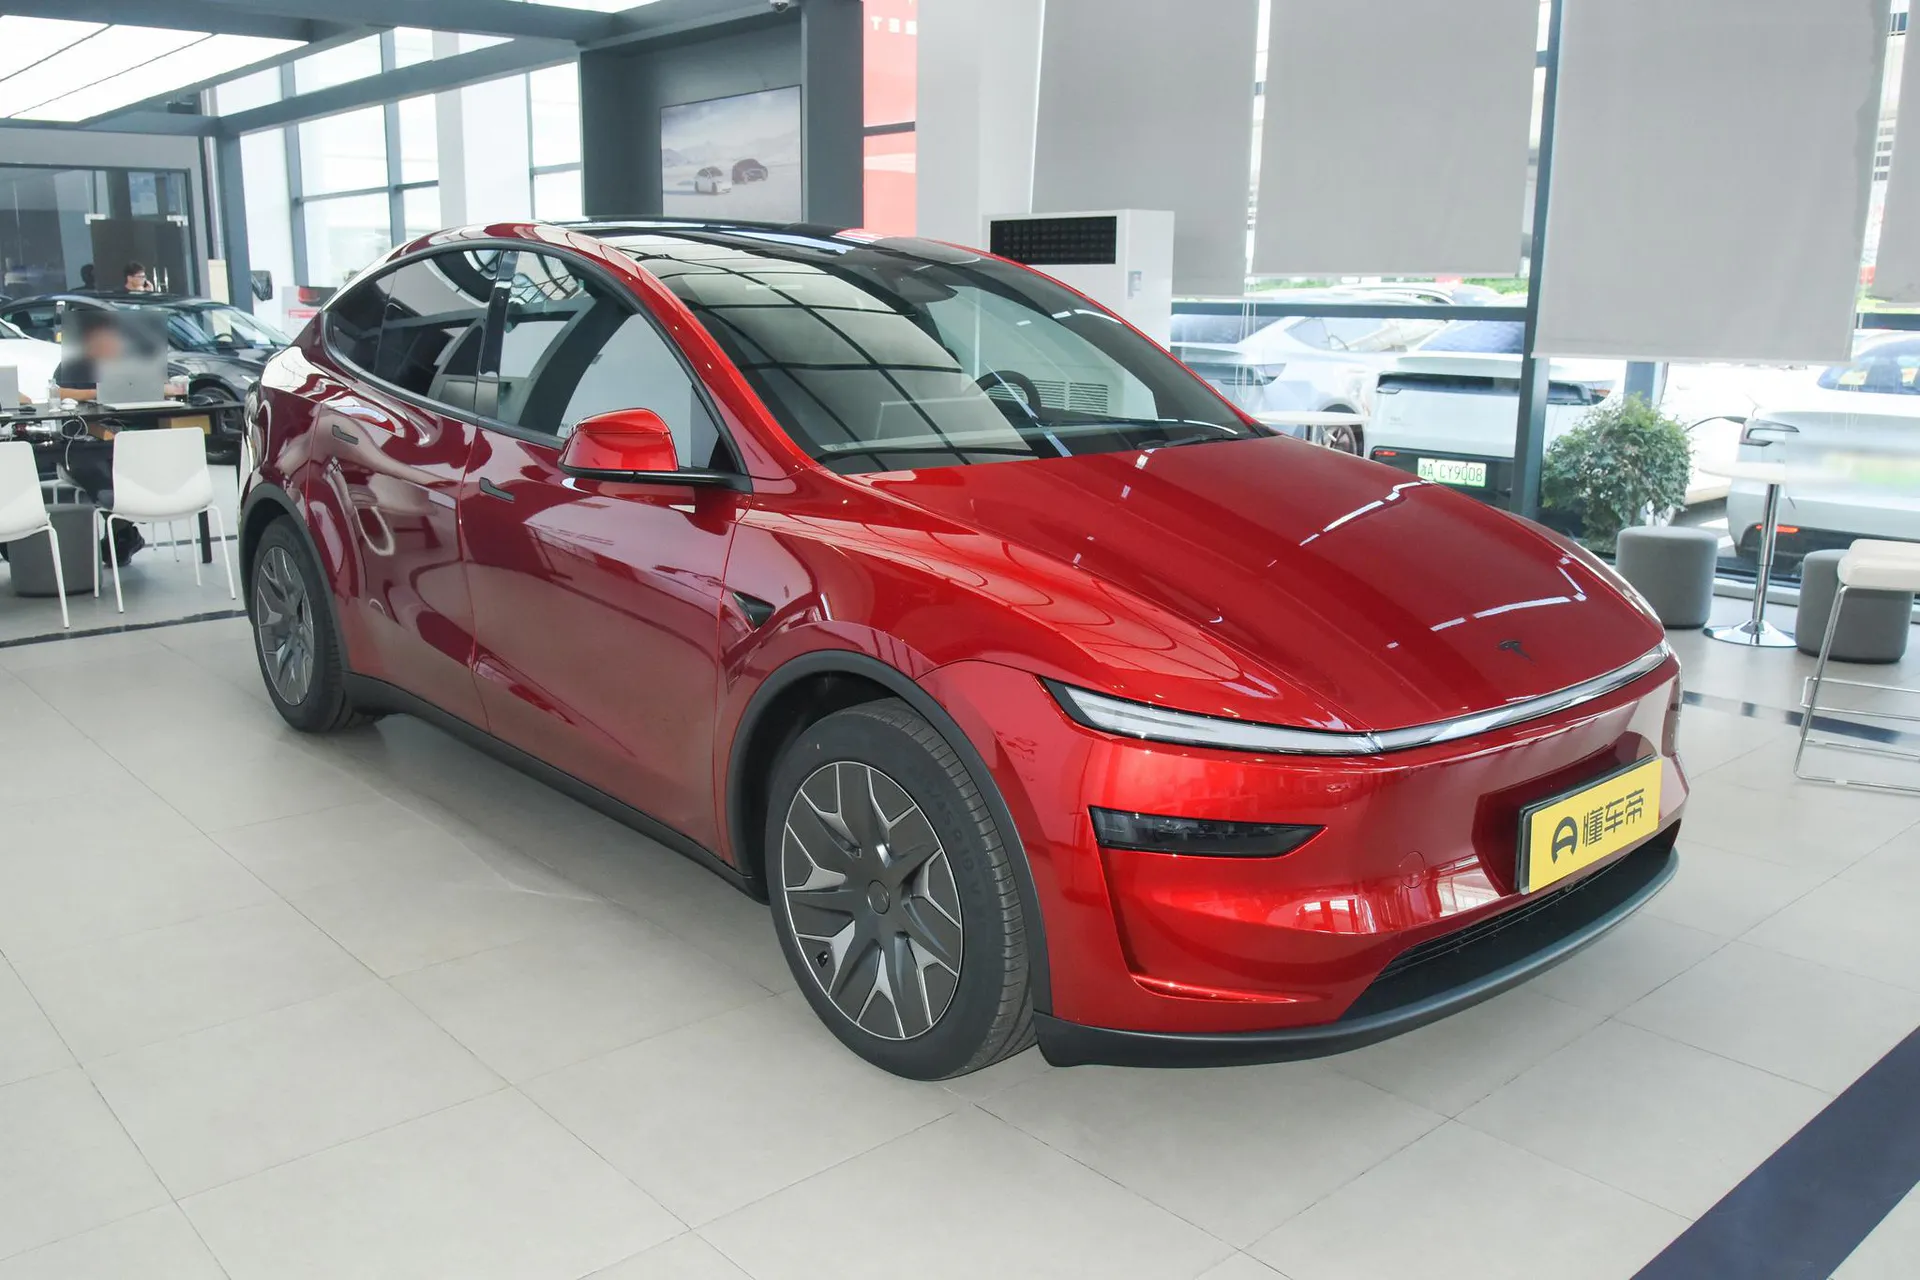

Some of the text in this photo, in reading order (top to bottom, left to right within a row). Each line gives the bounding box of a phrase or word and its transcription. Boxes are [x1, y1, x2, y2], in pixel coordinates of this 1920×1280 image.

[1439, 463, 1483, 482] CY9008
[1582, 788, 1645, 848] 懂车帝
